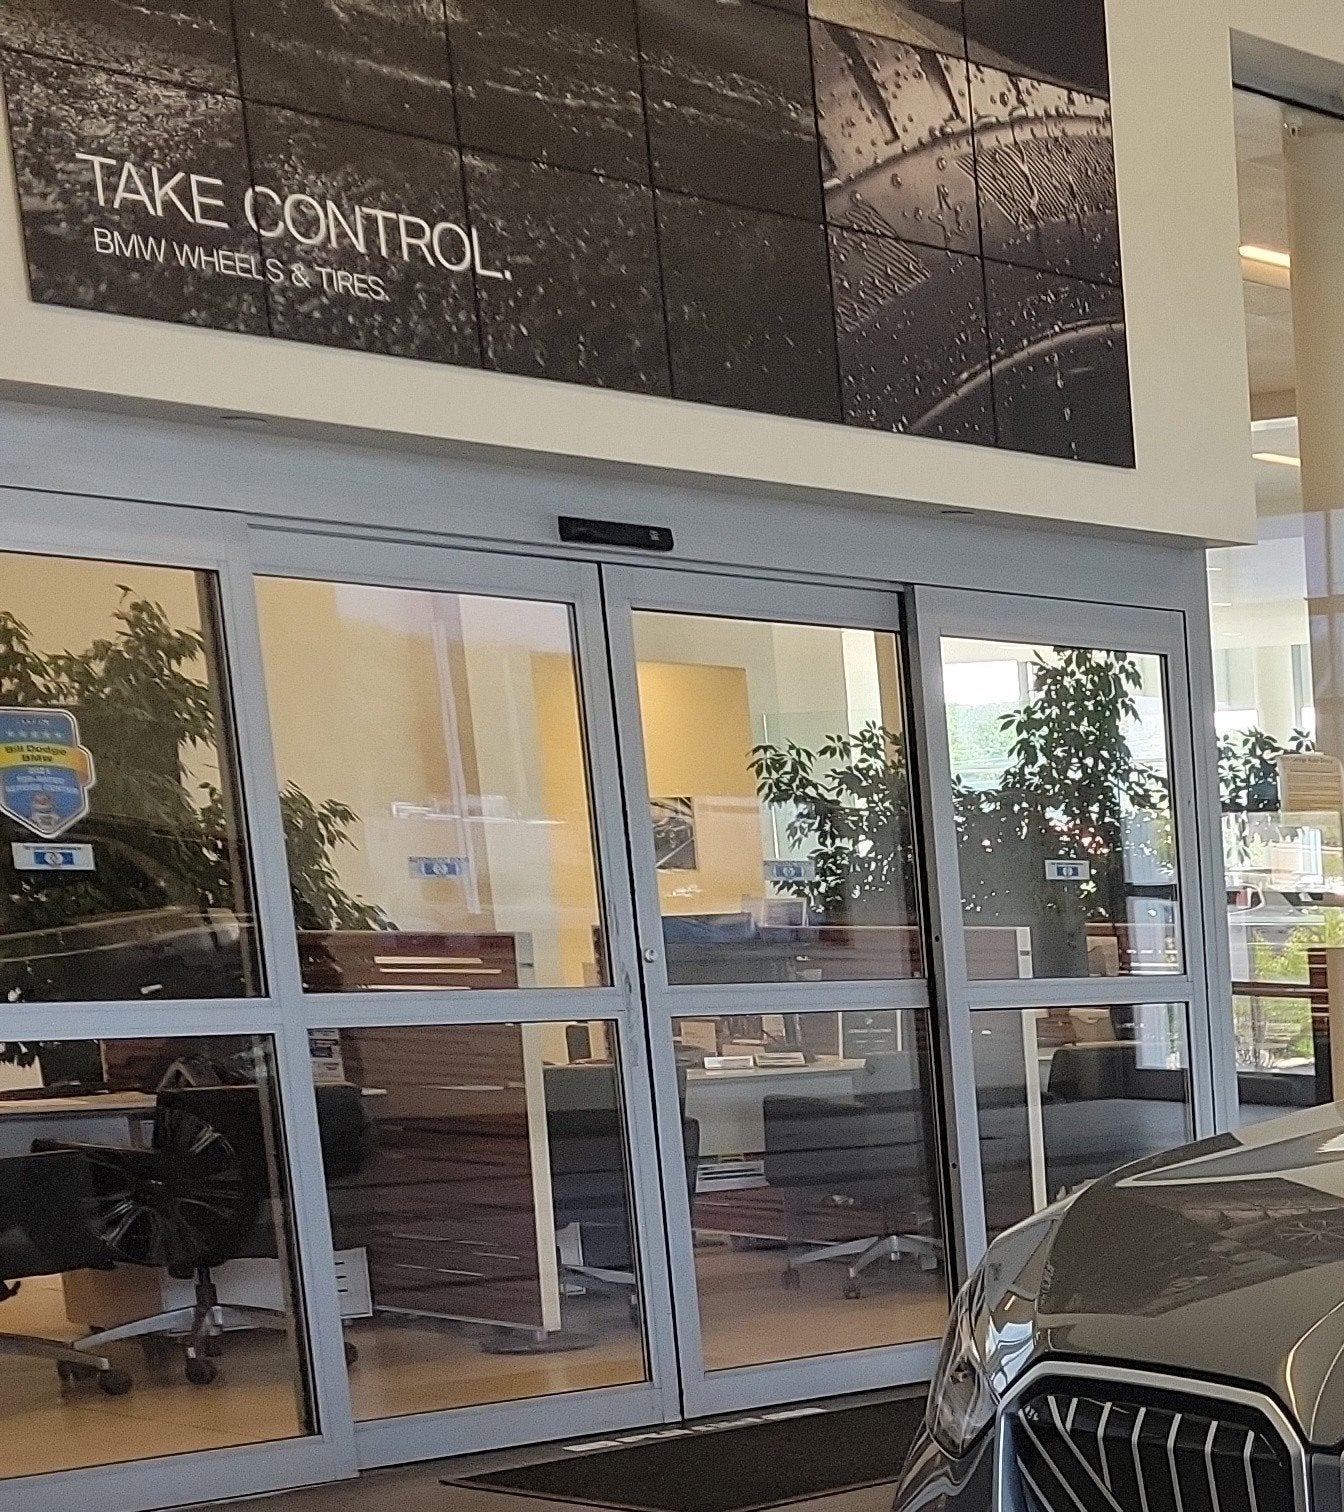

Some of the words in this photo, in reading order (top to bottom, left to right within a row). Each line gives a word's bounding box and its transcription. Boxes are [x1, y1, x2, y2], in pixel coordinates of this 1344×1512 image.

[75, 152, 230, 229] TAKE
[244, 185, 513, 282] CONTROL.
[93, 227, 165, 264] BMW
[172, 240, 284, 283] WHEELS
[291, 262, 311, 289] &
[313, 264, 391, 302] TIRES.
[26, 744, 67, 756] Dodge
